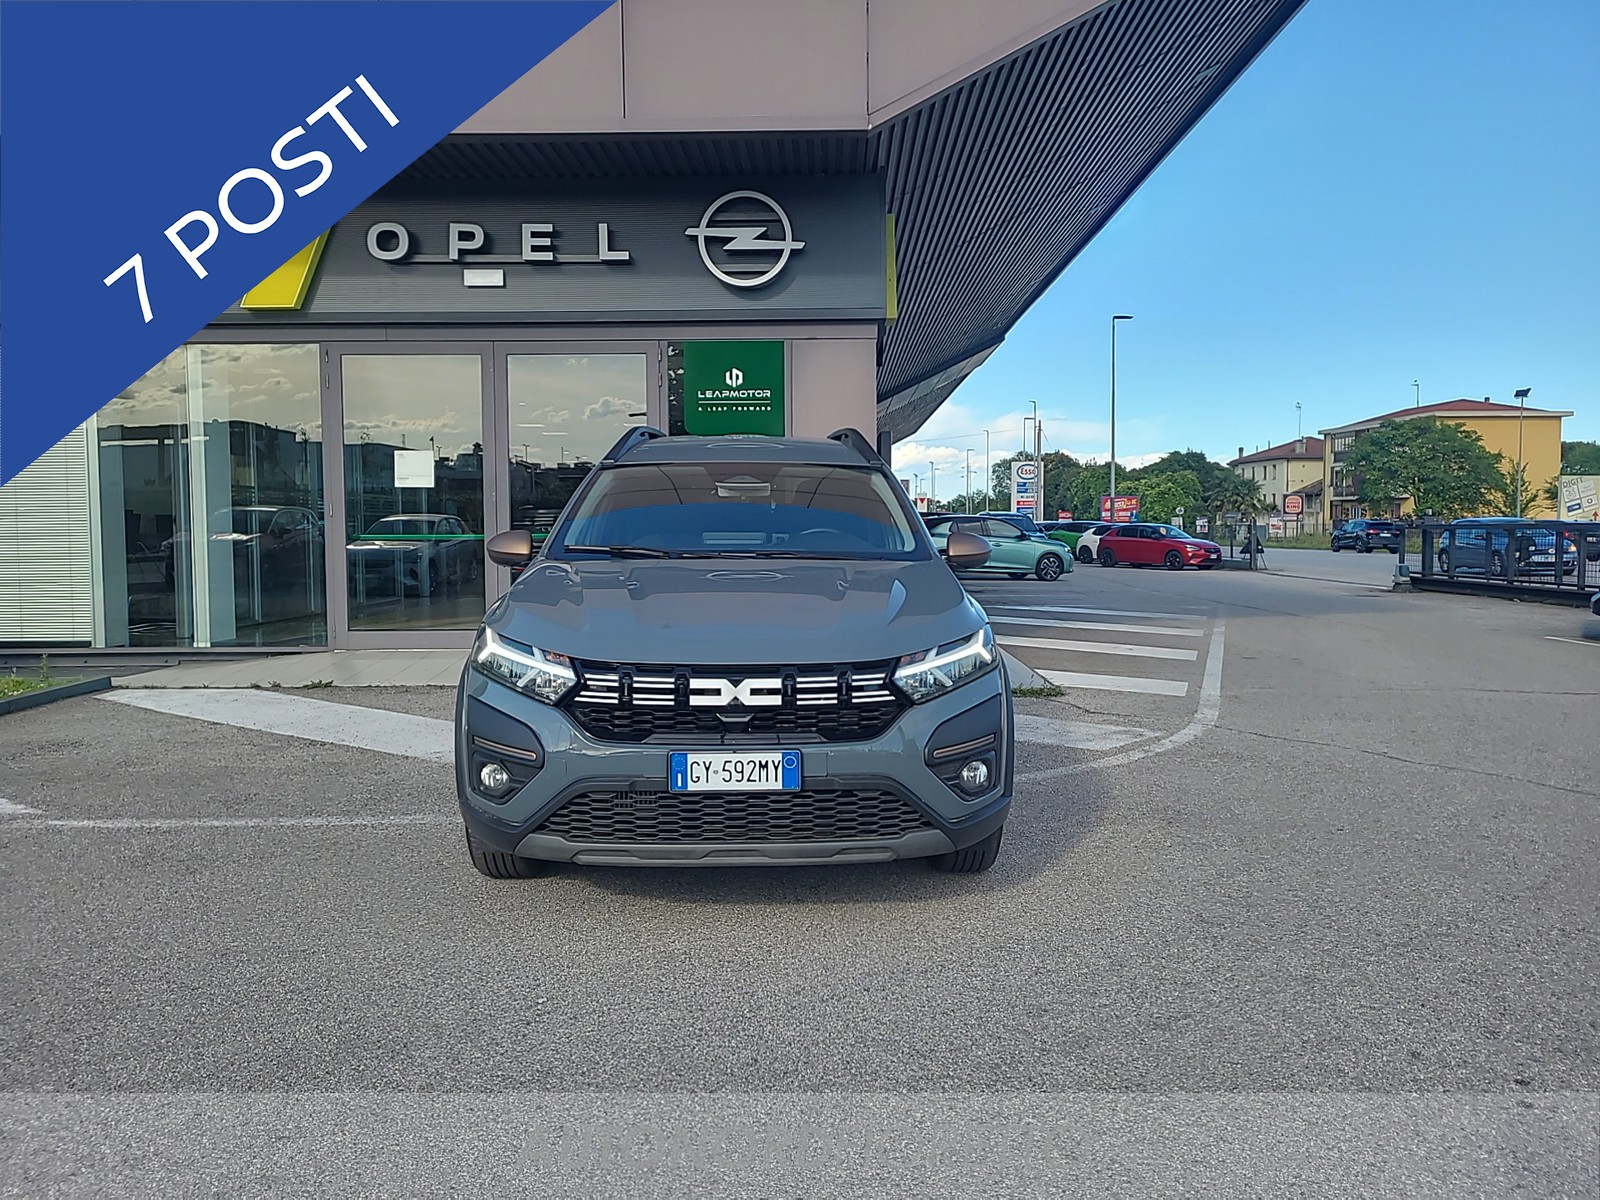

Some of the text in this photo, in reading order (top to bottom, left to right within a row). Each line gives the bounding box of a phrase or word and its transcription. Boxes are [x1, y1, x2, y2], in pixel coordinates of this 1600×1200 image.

[366, 221, 630, 261] OPEL
[697, 389, 771, 398] LEAPMOTOR
[690, 760, 712, 783] GY
[721, 760, 781, 783] 592MY
